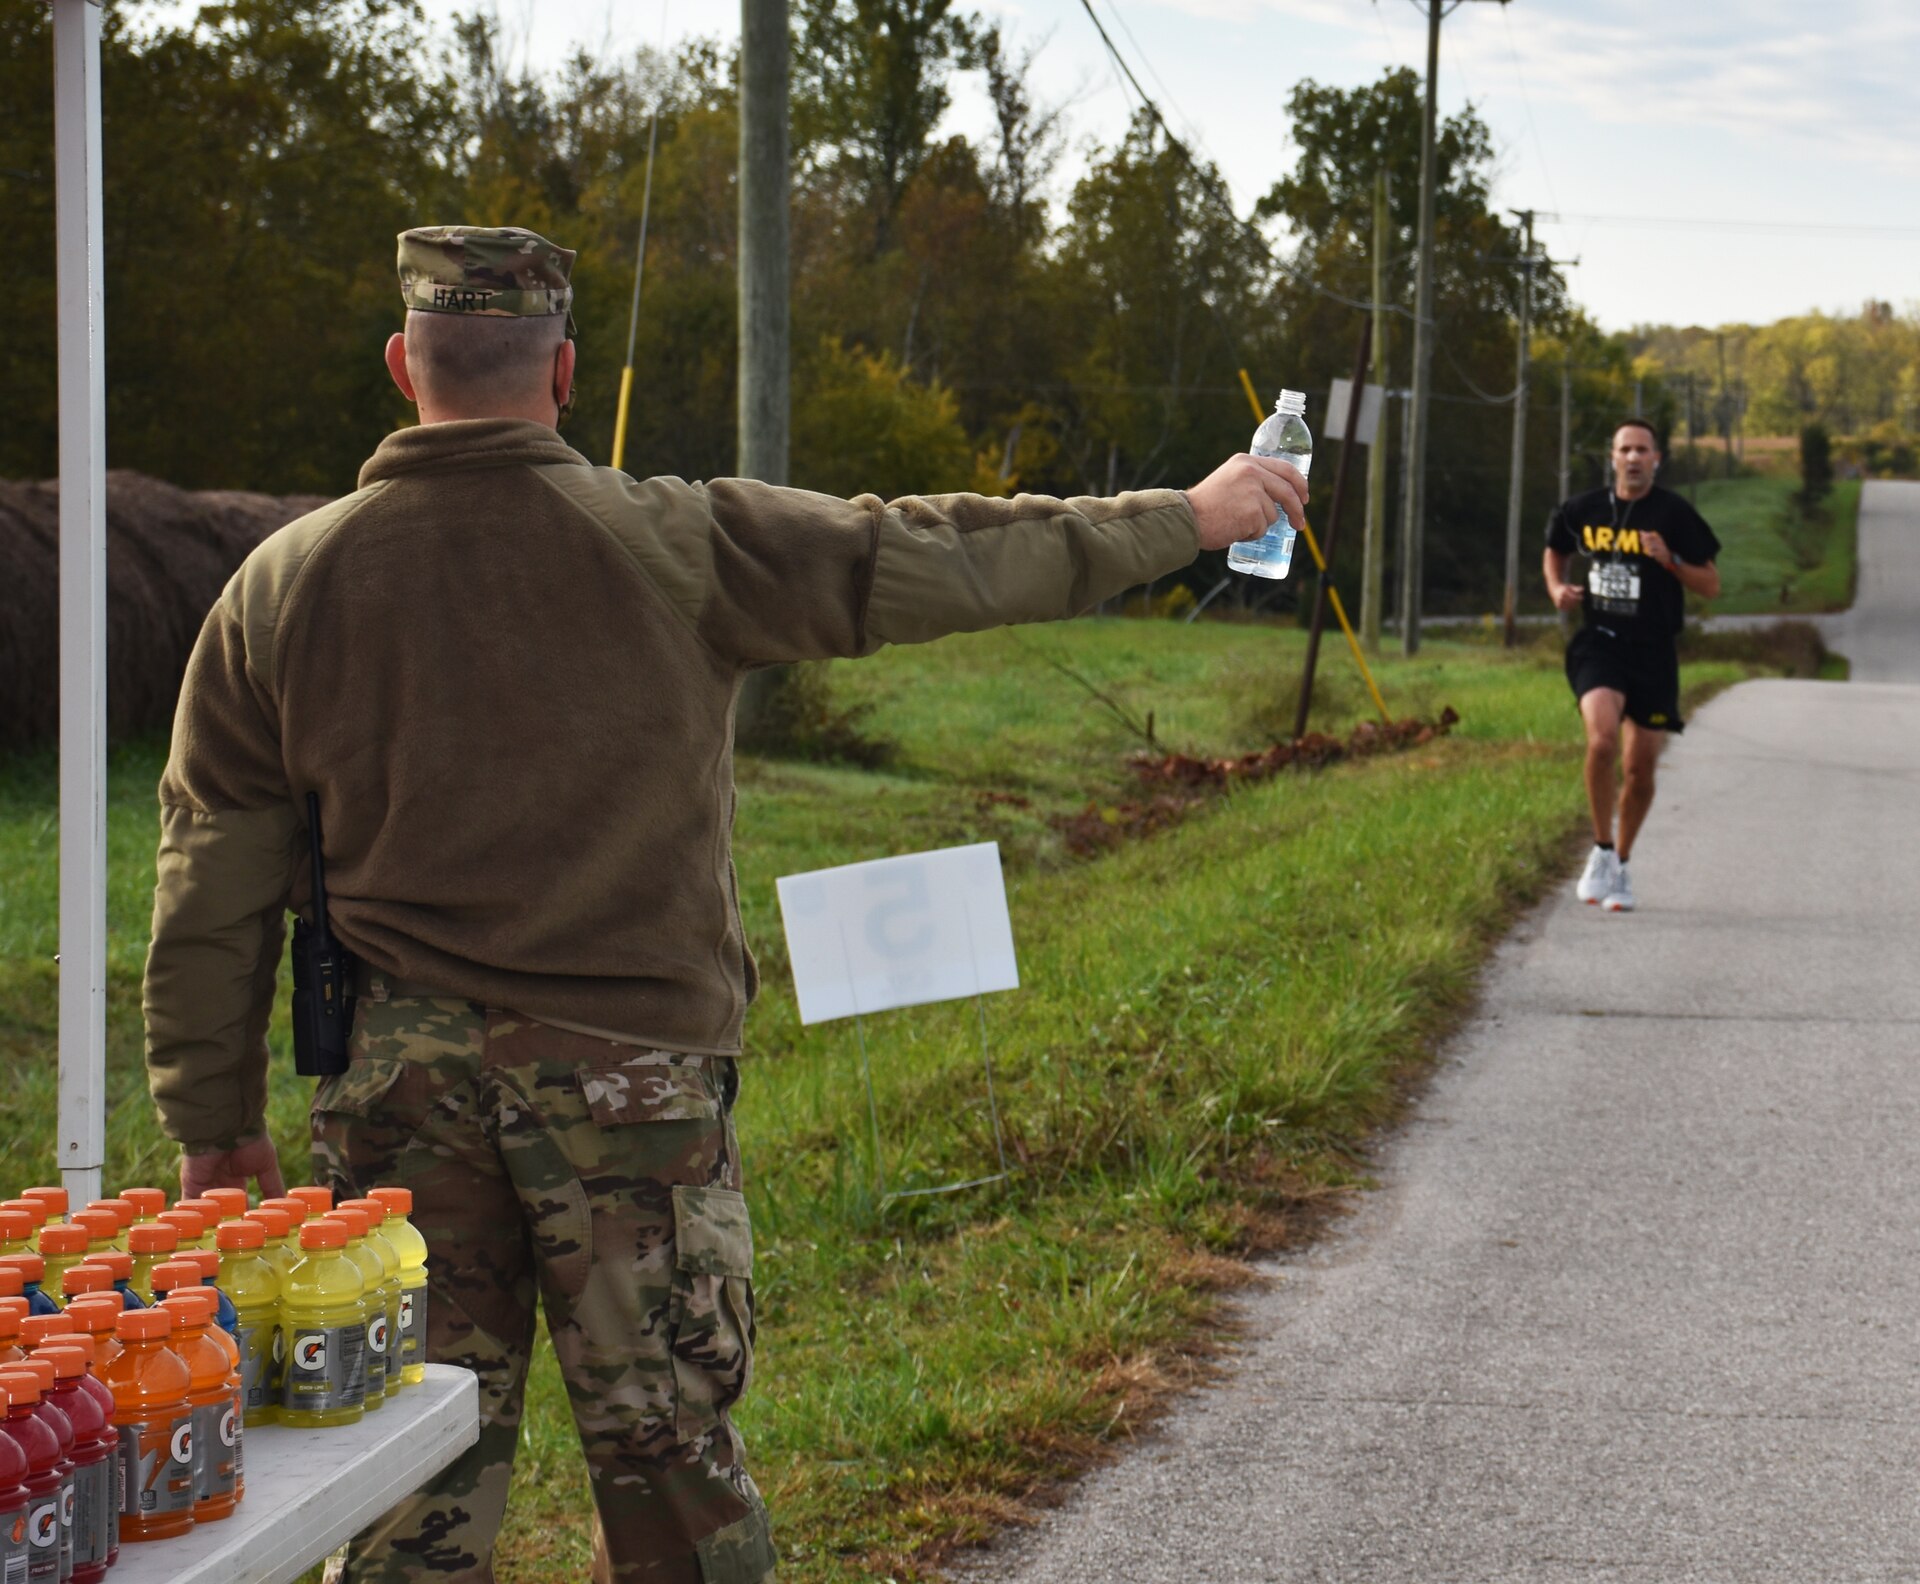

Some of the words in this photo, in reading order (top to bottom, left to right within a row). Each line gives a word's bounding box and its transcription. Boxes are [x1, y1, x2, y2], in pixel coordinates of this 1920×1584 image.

[433, 288, 493, 311] HART
[294, 1334, 326, 1371] G
[29, 1502, 57, 1548] G
